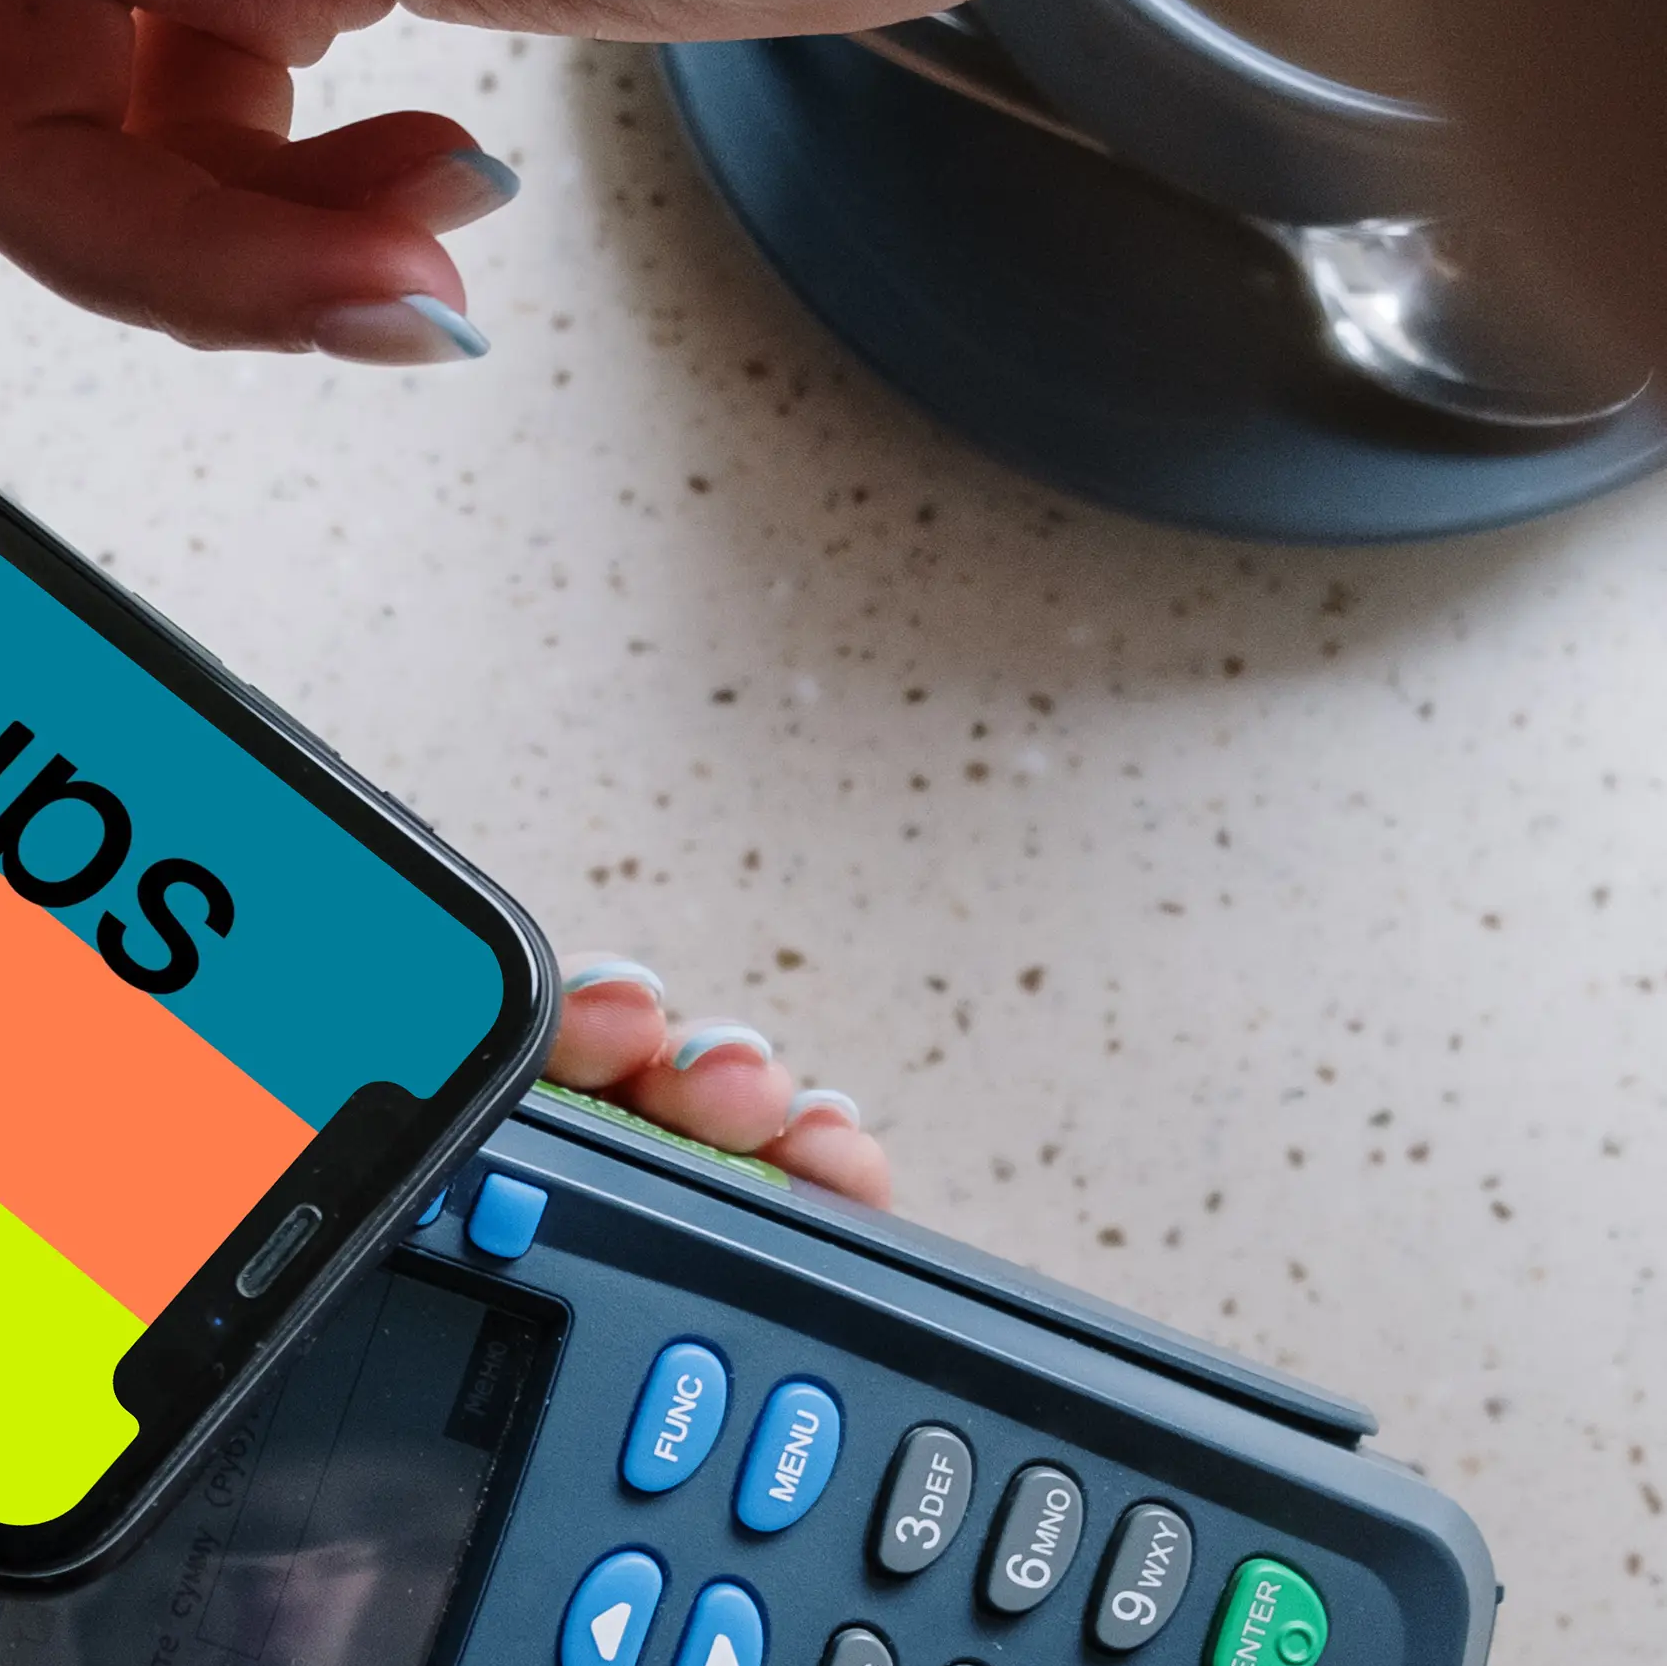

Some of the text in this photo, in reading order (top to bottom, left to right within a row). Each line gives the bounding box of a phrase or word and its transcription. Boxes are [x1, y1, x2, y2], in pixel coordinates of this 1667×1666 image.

[463, 1340, 508, 1416] Меню
[653, 1373, 703, 1462] FUNC
[768, 1409, 820, 1502] MENU
[1111, 1520, 1179, 1626] 9 WXY
